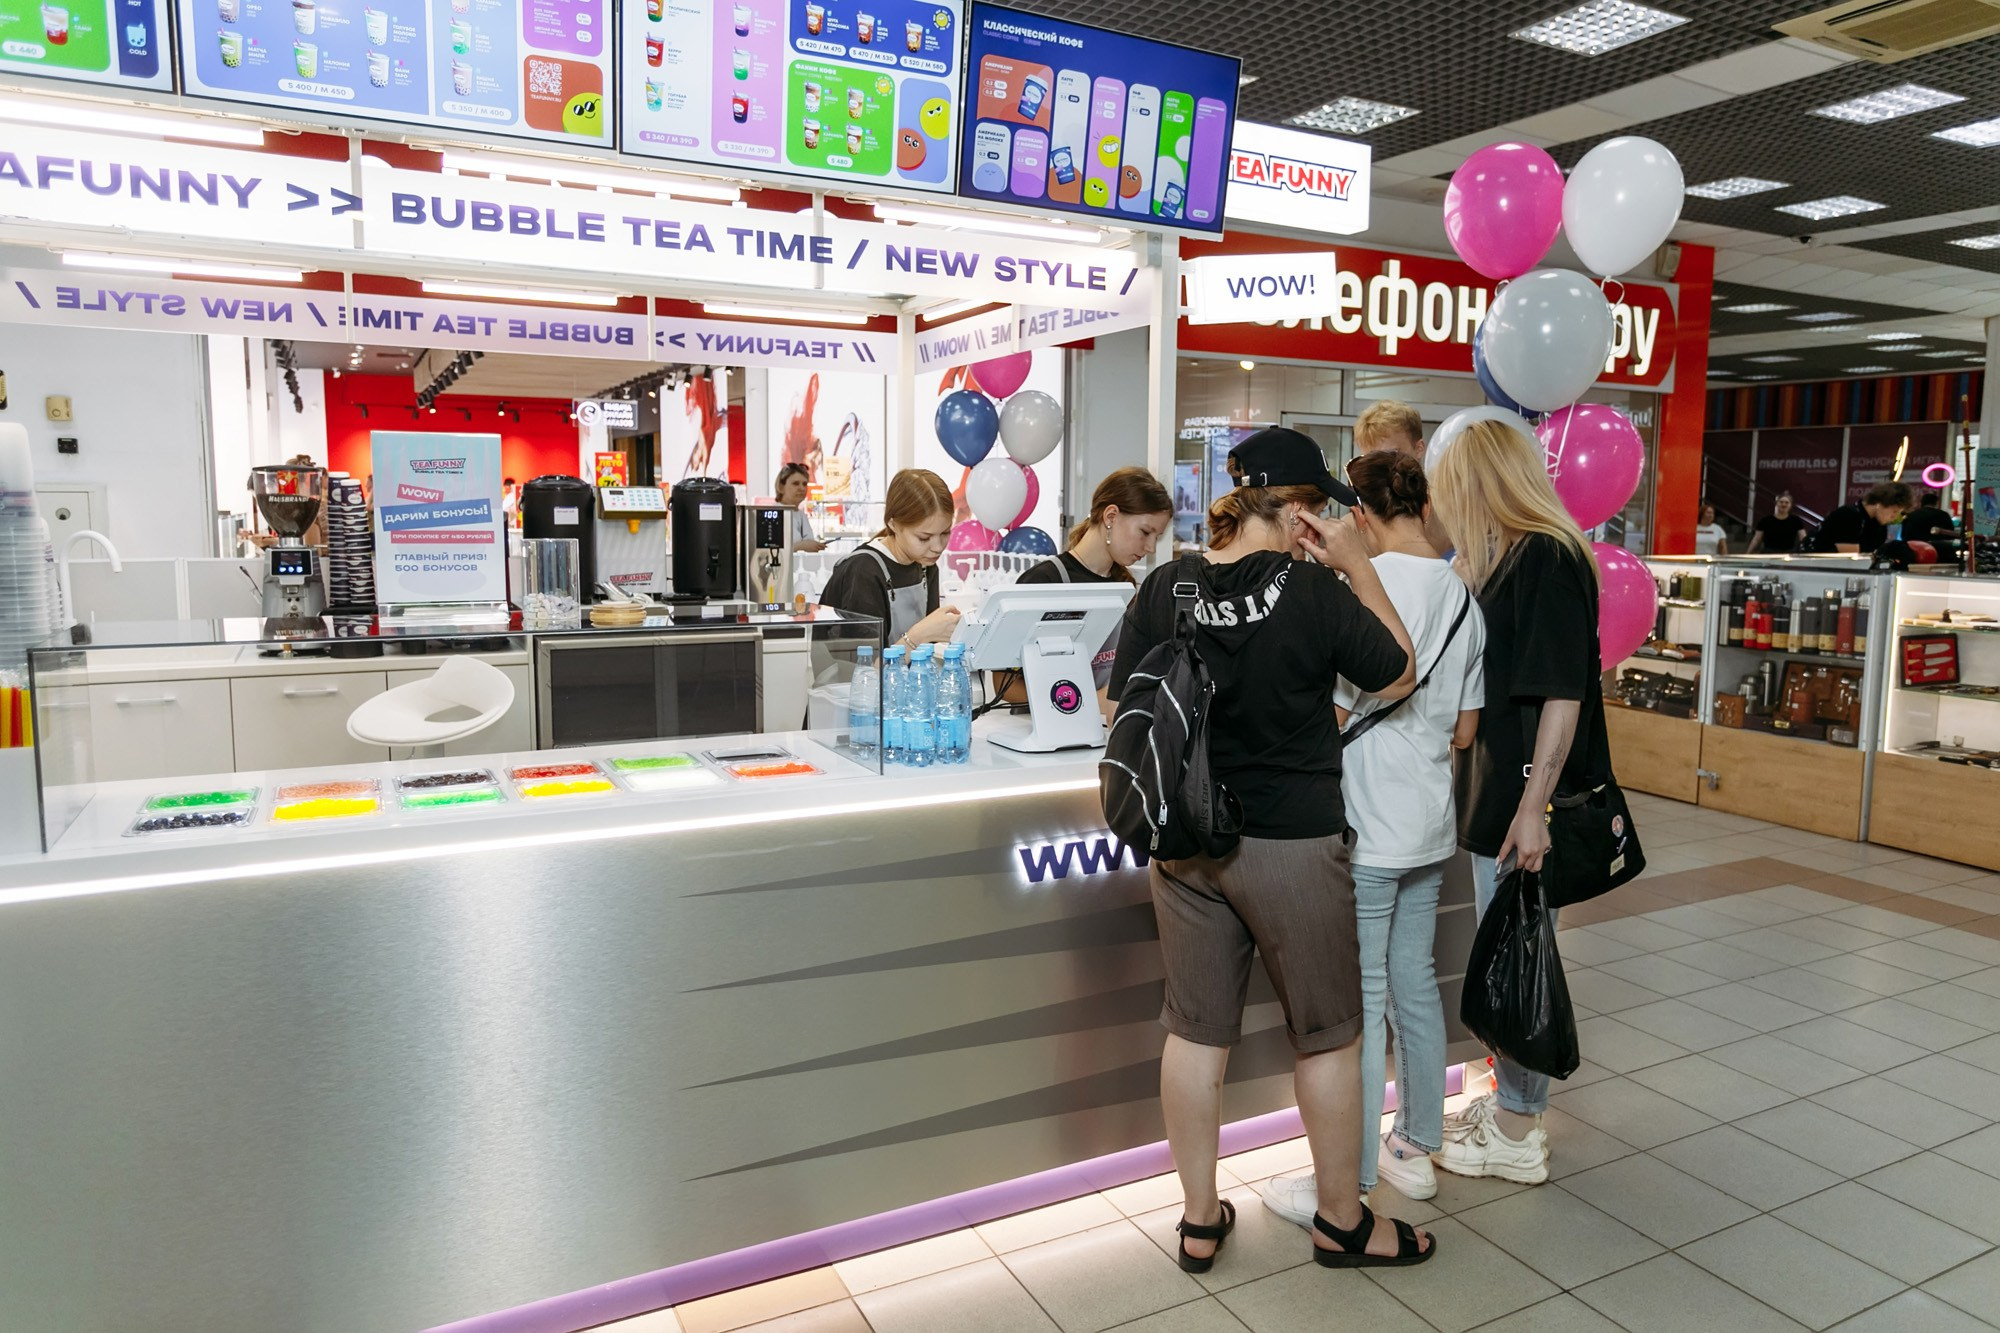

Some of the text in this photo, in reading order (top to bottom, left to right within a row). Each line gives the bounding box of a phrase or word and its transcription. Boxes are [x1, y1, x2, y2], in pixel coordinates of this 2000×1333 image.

[983, 20, 1057, 43] КЛАССИЧЕСКИЙ
[1058, 35, 1083, 48] КОФЕ
[129, 48, 147, 56] COLD
[831, 45, 842, 53] 470
[882, 54, 894, 62] 530
[819, 66, 836, 75] КОФЕ
[296, 83, 312, 91] 400
[320, 86, 329, 94] M
[331, 88, 346, 96] 450
[458, 105, 473, 113] 350
[480, 106, 488, 114] M
[489, 108, 504, 116] 400
[1230, 155, 1350, 195] EA FUNNY
[0, 151, 262, 209] AFUNNY
[392, 192, 1138, 296] BUBBLE TEA TIME / NEW STYLE /
[1226, 274, 1315, 299] WOW!
[432, 460, 463, 468] FUNNY
[599, 459, 623, 468] ЛЕТО
[401, 486, 440, 501] WOW!
[269, 495, 310, 503] HAUSBRAND
[385, 504, 489, 524] ДАРИМ БОНУСЫ!
[764, 511, 778, 519] 100
[394, 552, 487, 561] ГЛАВНЫЙ ПРИЗ!
[423, 564, 478, 572] БОНУСОВ
